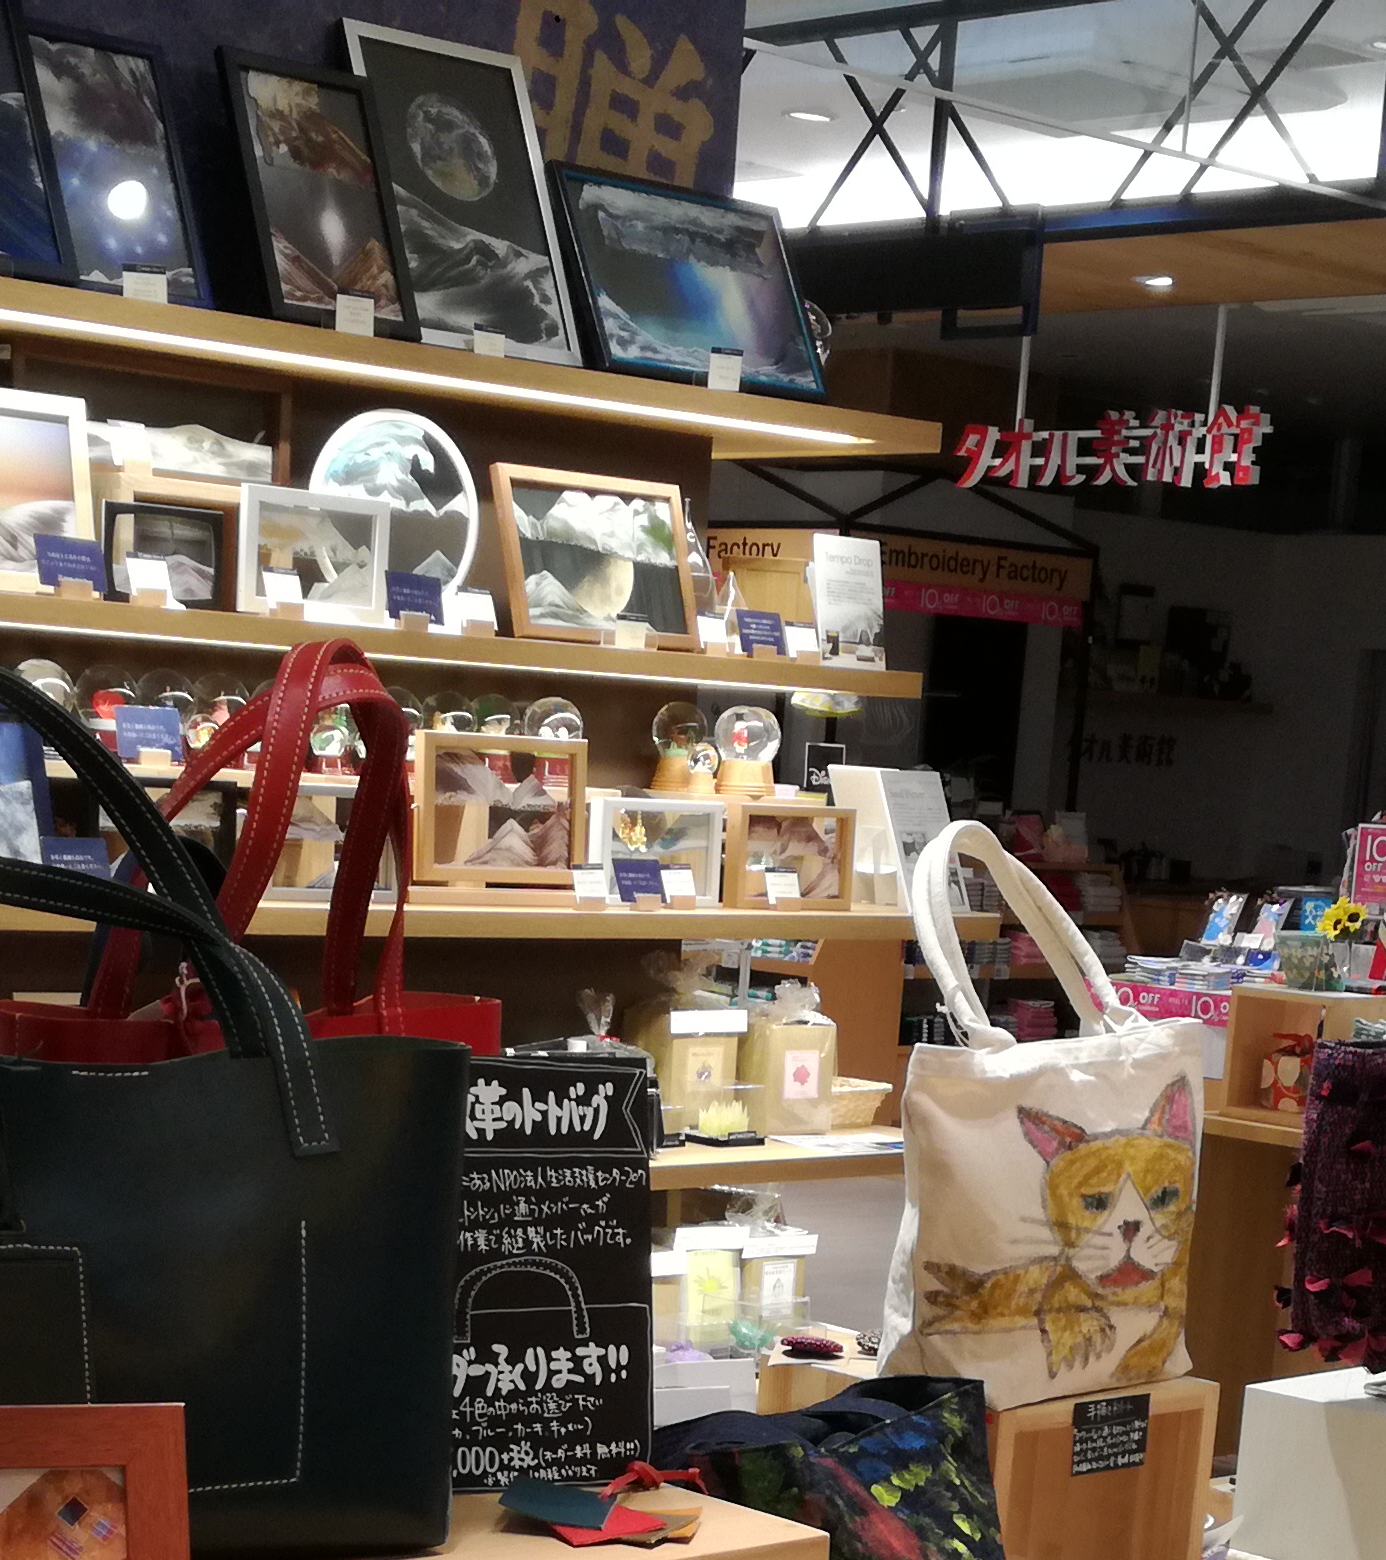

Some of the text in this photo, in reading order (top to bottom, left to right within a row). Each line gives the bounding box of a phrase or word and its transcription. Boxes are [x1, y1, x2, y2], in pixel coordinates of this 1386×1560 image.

[954, 404, 1273, 488] タオル美術館
[995, 555, 1068, 590] Factory
[1071, 731, 1176, 767] オル美術館
[1364, 862, 1384, 872] OFF
[1139, 992, 1161, 1005] OFF
